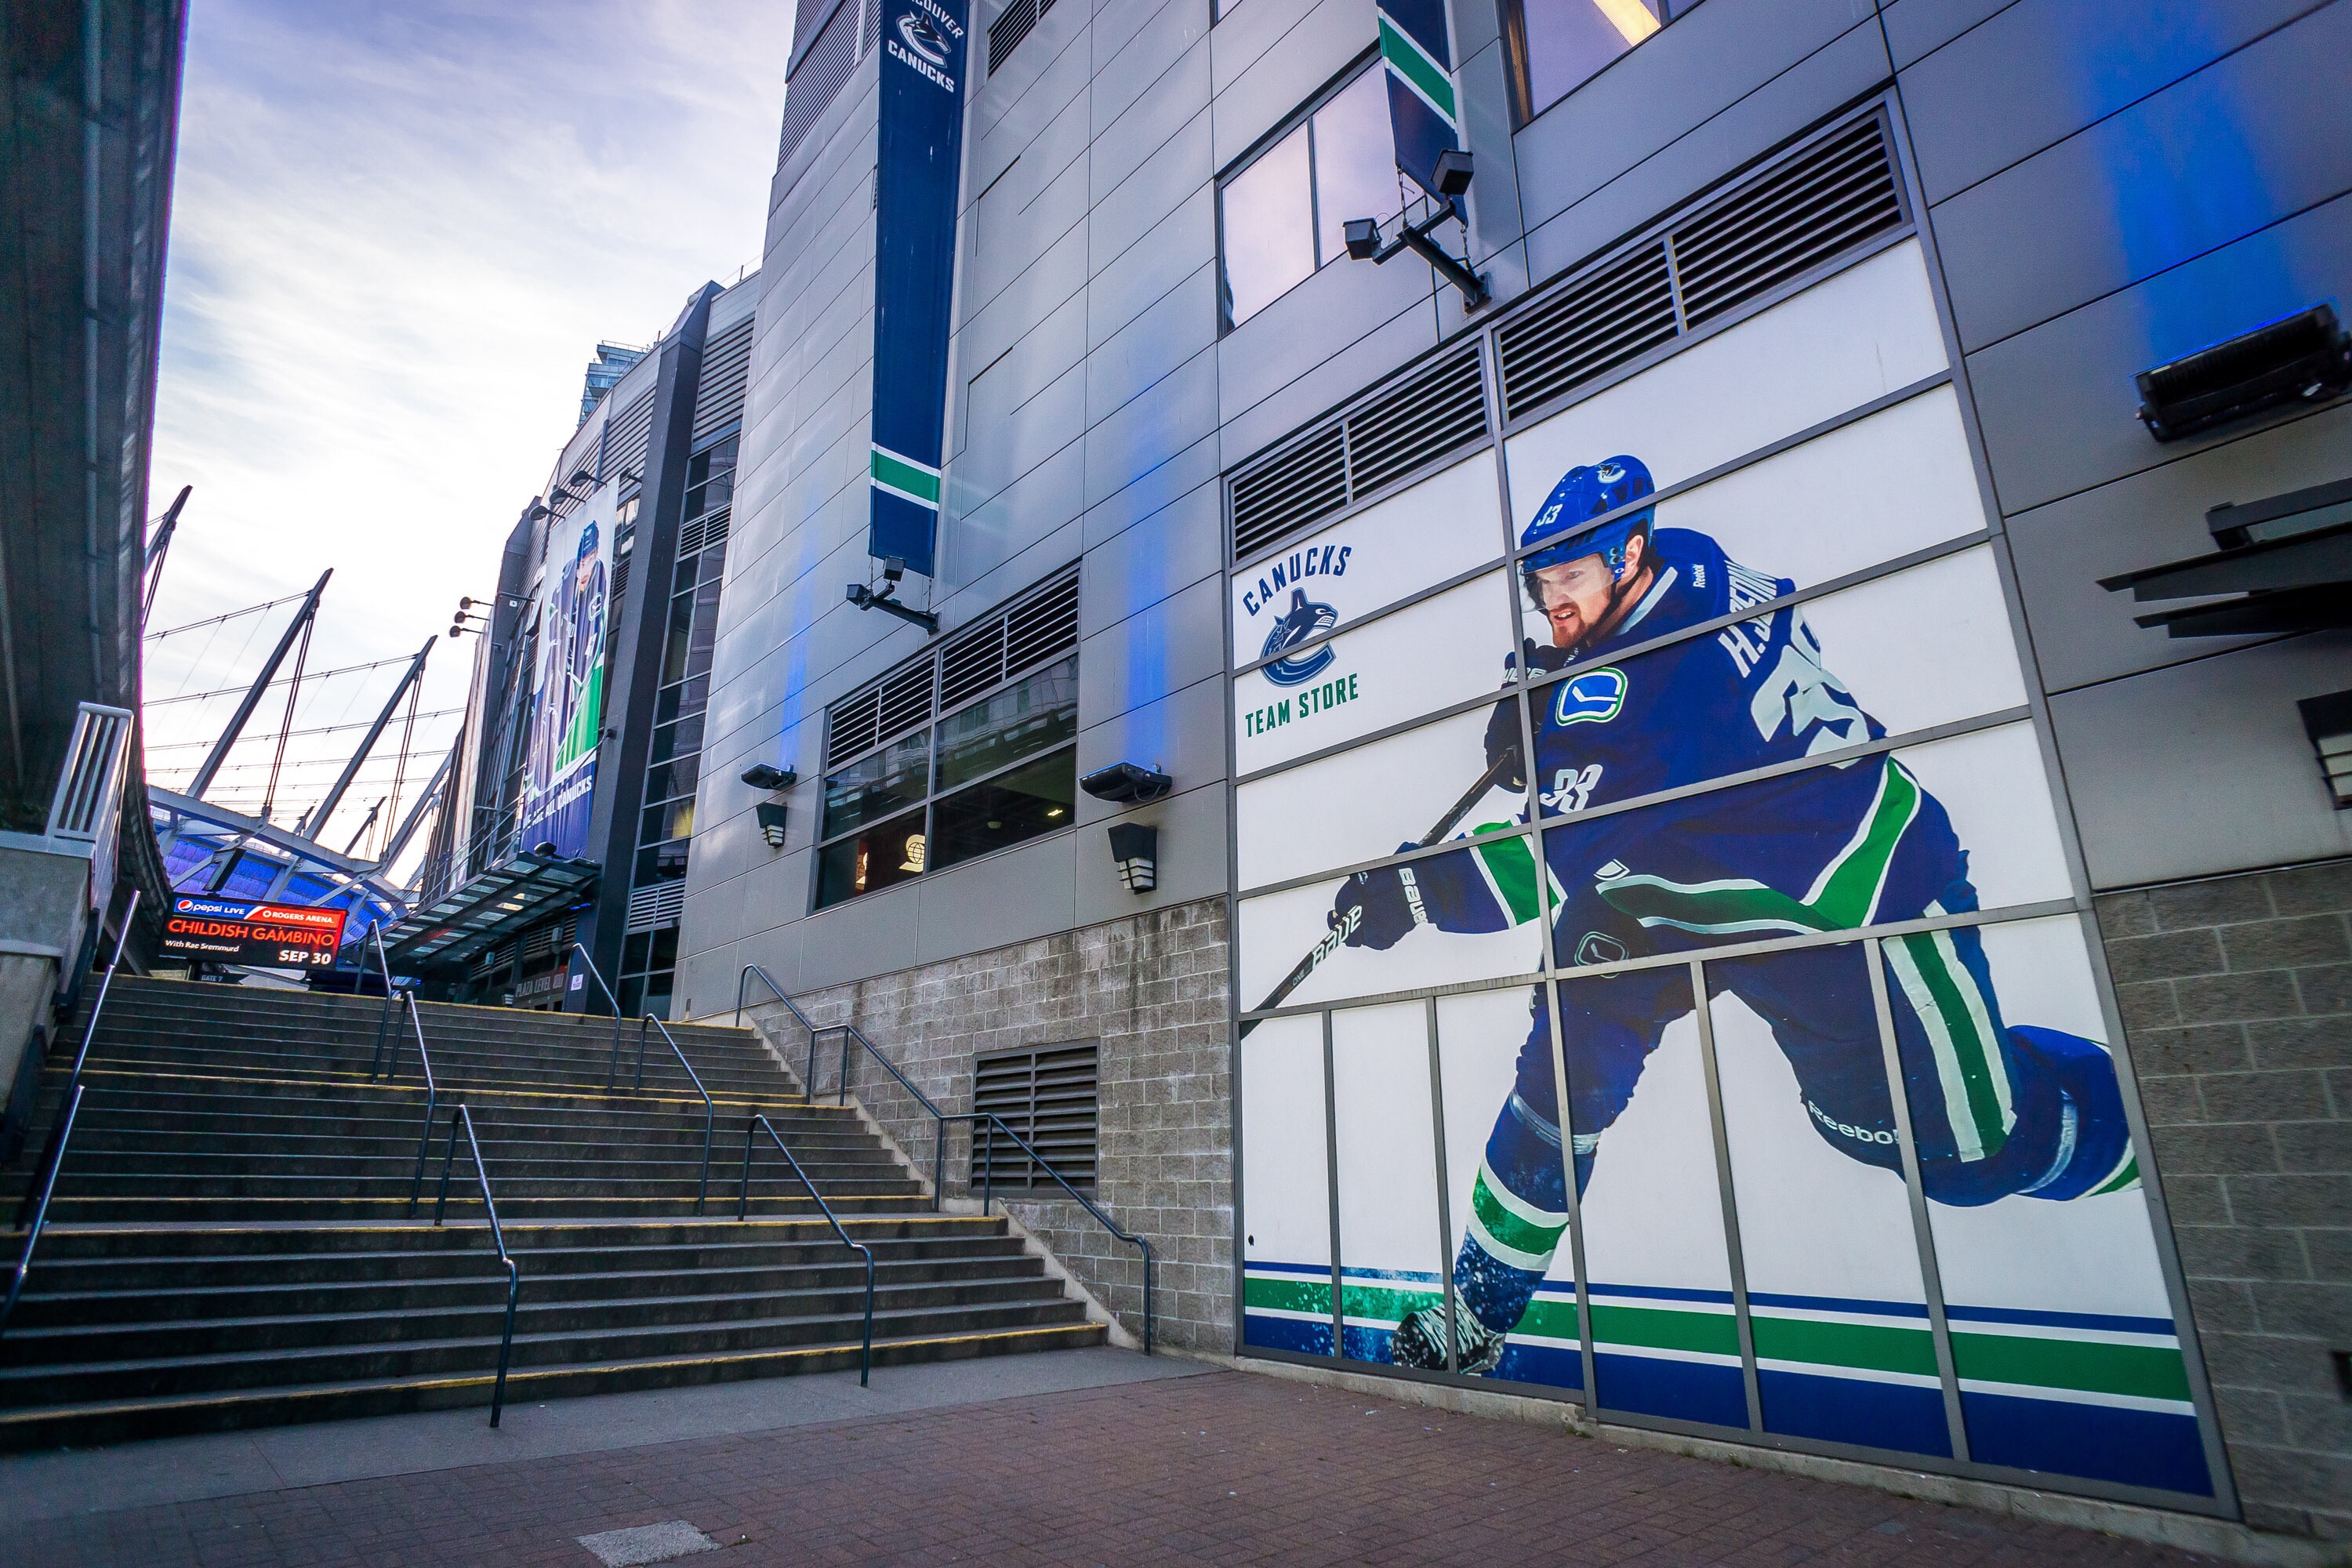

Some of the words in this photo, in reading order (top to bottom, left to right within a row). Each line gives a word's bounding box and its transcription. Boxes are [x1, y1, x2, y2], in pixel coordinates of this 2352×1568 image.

[887, 39, 954, 93] CANUCKS
[1243, 545, 1352, 617] CANUCKS
[1693, 564, 1706, 588] Reebok
[1245, 699, 1291, 739] TEAM
[1298, 673, 1359, 719] STORE
[546, 798, 557, 818] ALL
[557, 775, 593, 811] CANUCKS
[193, 904, 223, 915] pepsi
[224, 906, 245, 916] LIVE
[271, 912, 305, 921] ROGERS
[168, 920, 249, 939] CHILDISH
[252, 927, 336, 947] GAMBINO
[165, 939, 184, 949] With
[201, 942, 240, 953] Sremmurd
[278, 949, 309, 963] SEP
[311, 951, 332, 965] 30
[516, 981, 533, 998] PLAZA
[534, 976, 551, 993] LEVEL
